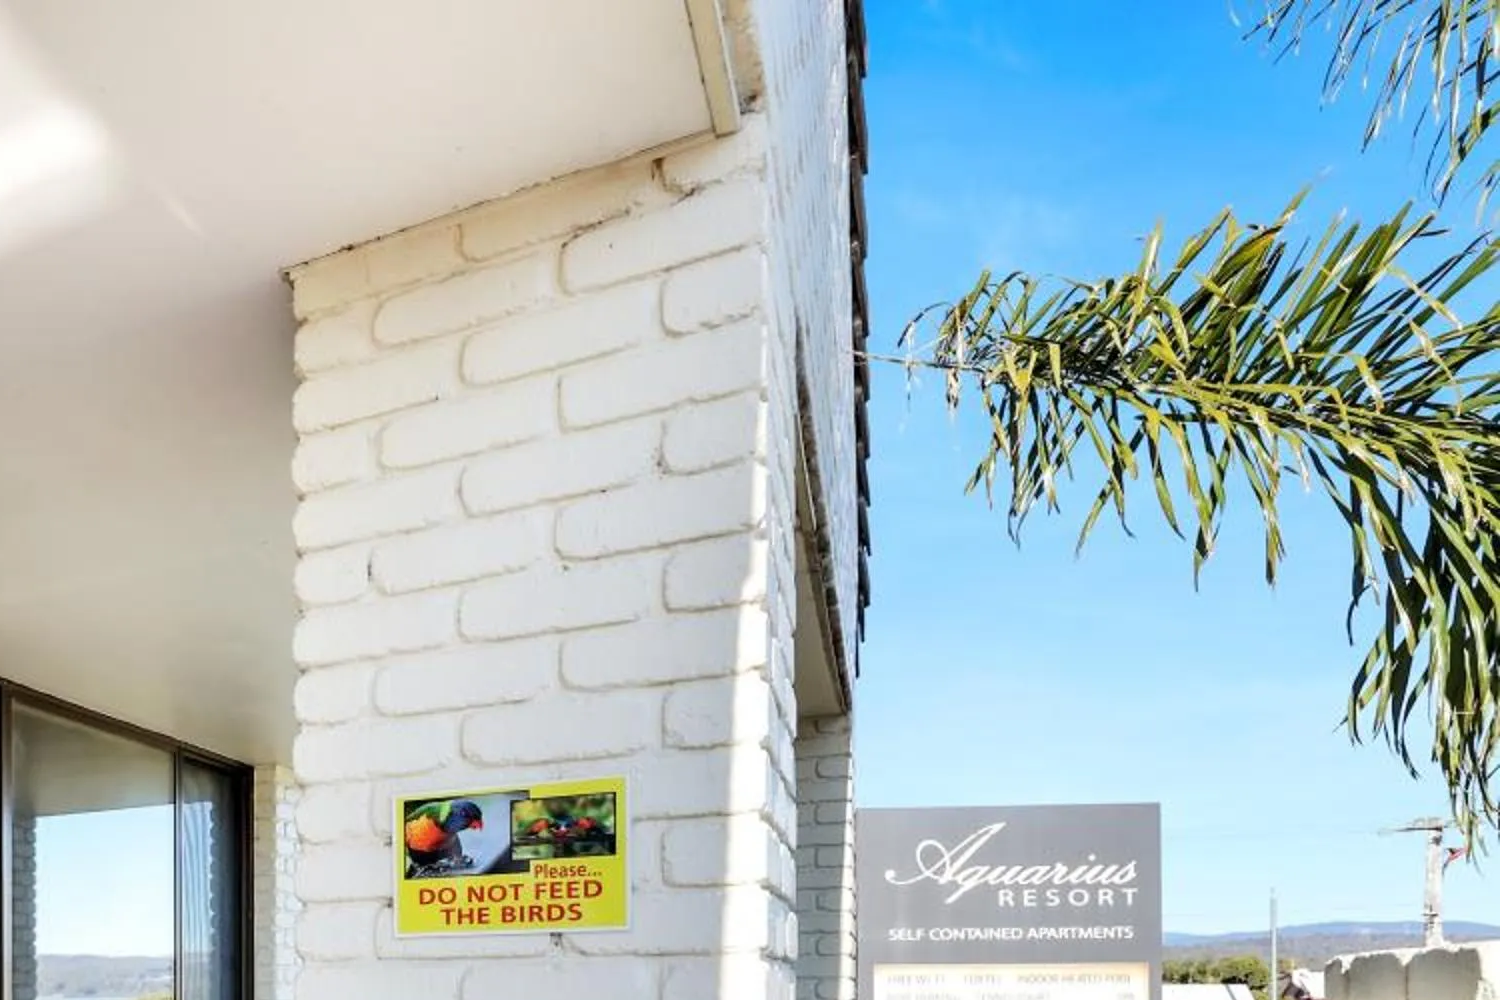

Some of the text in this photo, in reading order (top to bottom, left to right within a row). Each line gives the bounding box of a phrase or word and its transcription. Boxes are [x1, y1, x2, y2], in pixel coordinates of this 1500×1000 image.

[884, 821, 1138, 904] Aquarius
[419, 879, 603, 905] DO NOT FEED
[998, 887, 1138, 907] RESORT
[440, 903, 583, 925] THE BIRDS
[888, 925, 1134, 941] SELF CONTAINED APARTMENTS
